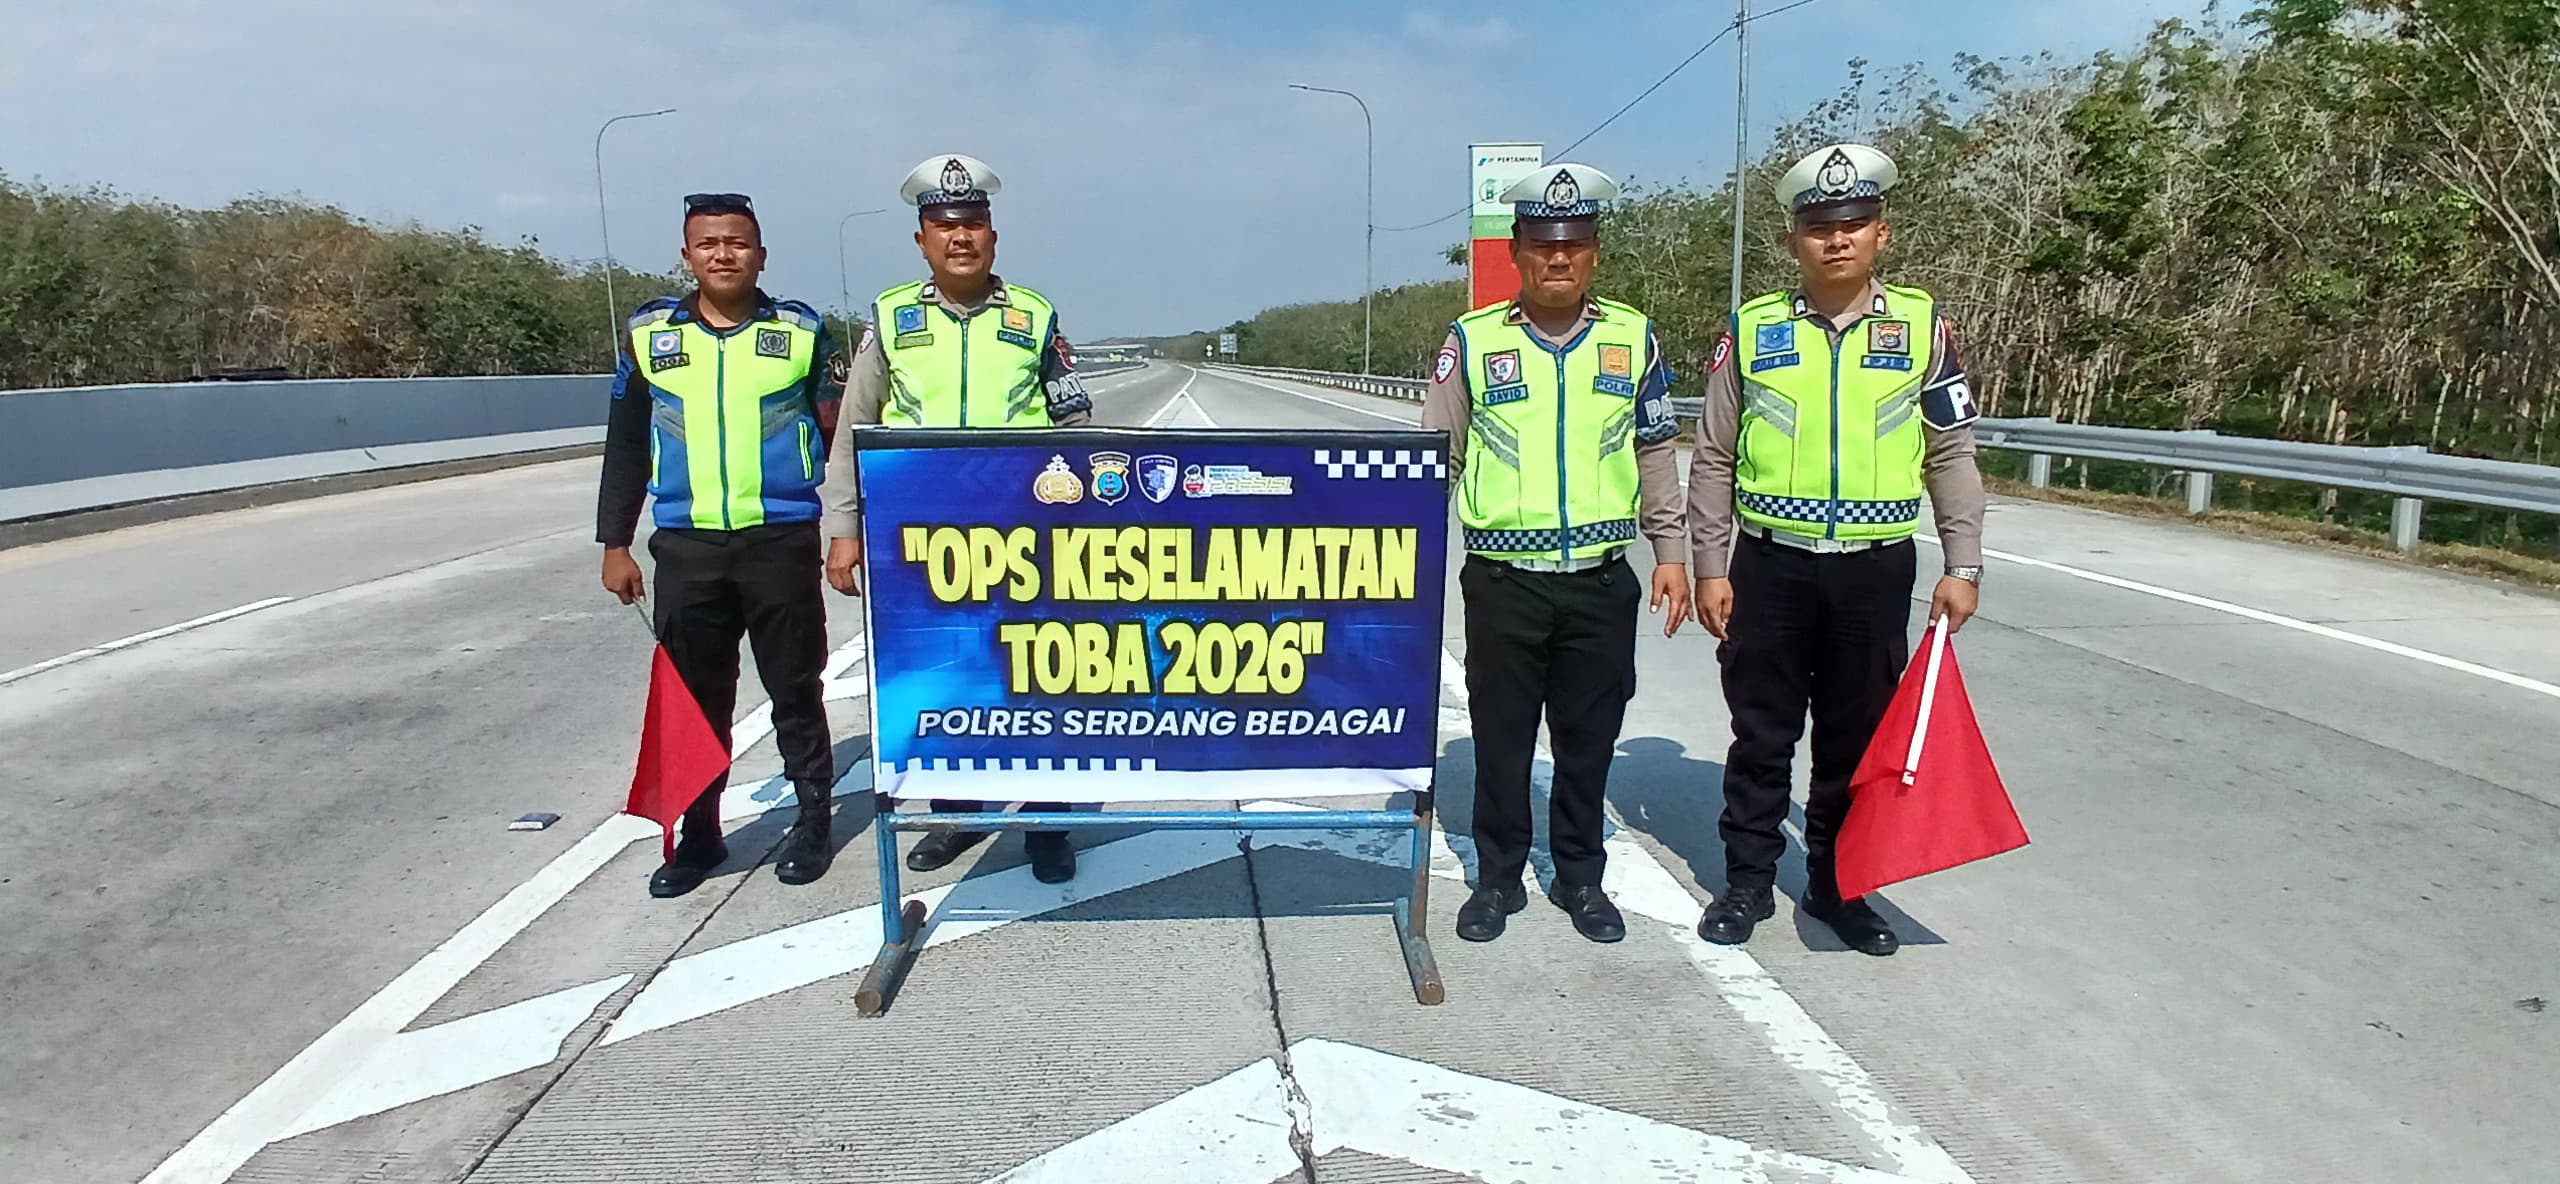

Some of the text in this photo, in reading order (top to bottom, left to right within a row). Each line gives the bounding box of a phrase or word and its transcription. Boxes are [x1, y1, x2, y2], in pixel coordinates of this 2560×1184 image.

[1046, 371, 1086, 403] PAT
[1488, 388, 1522, 403] DAVID
[904, 527, 1416, 601] "OPS KESELAMATAN
[1001, 622, 1323, 693] TOBA 2026"
[919, 709, 1405, 735] POLRES SERDANG BEDAGAI
